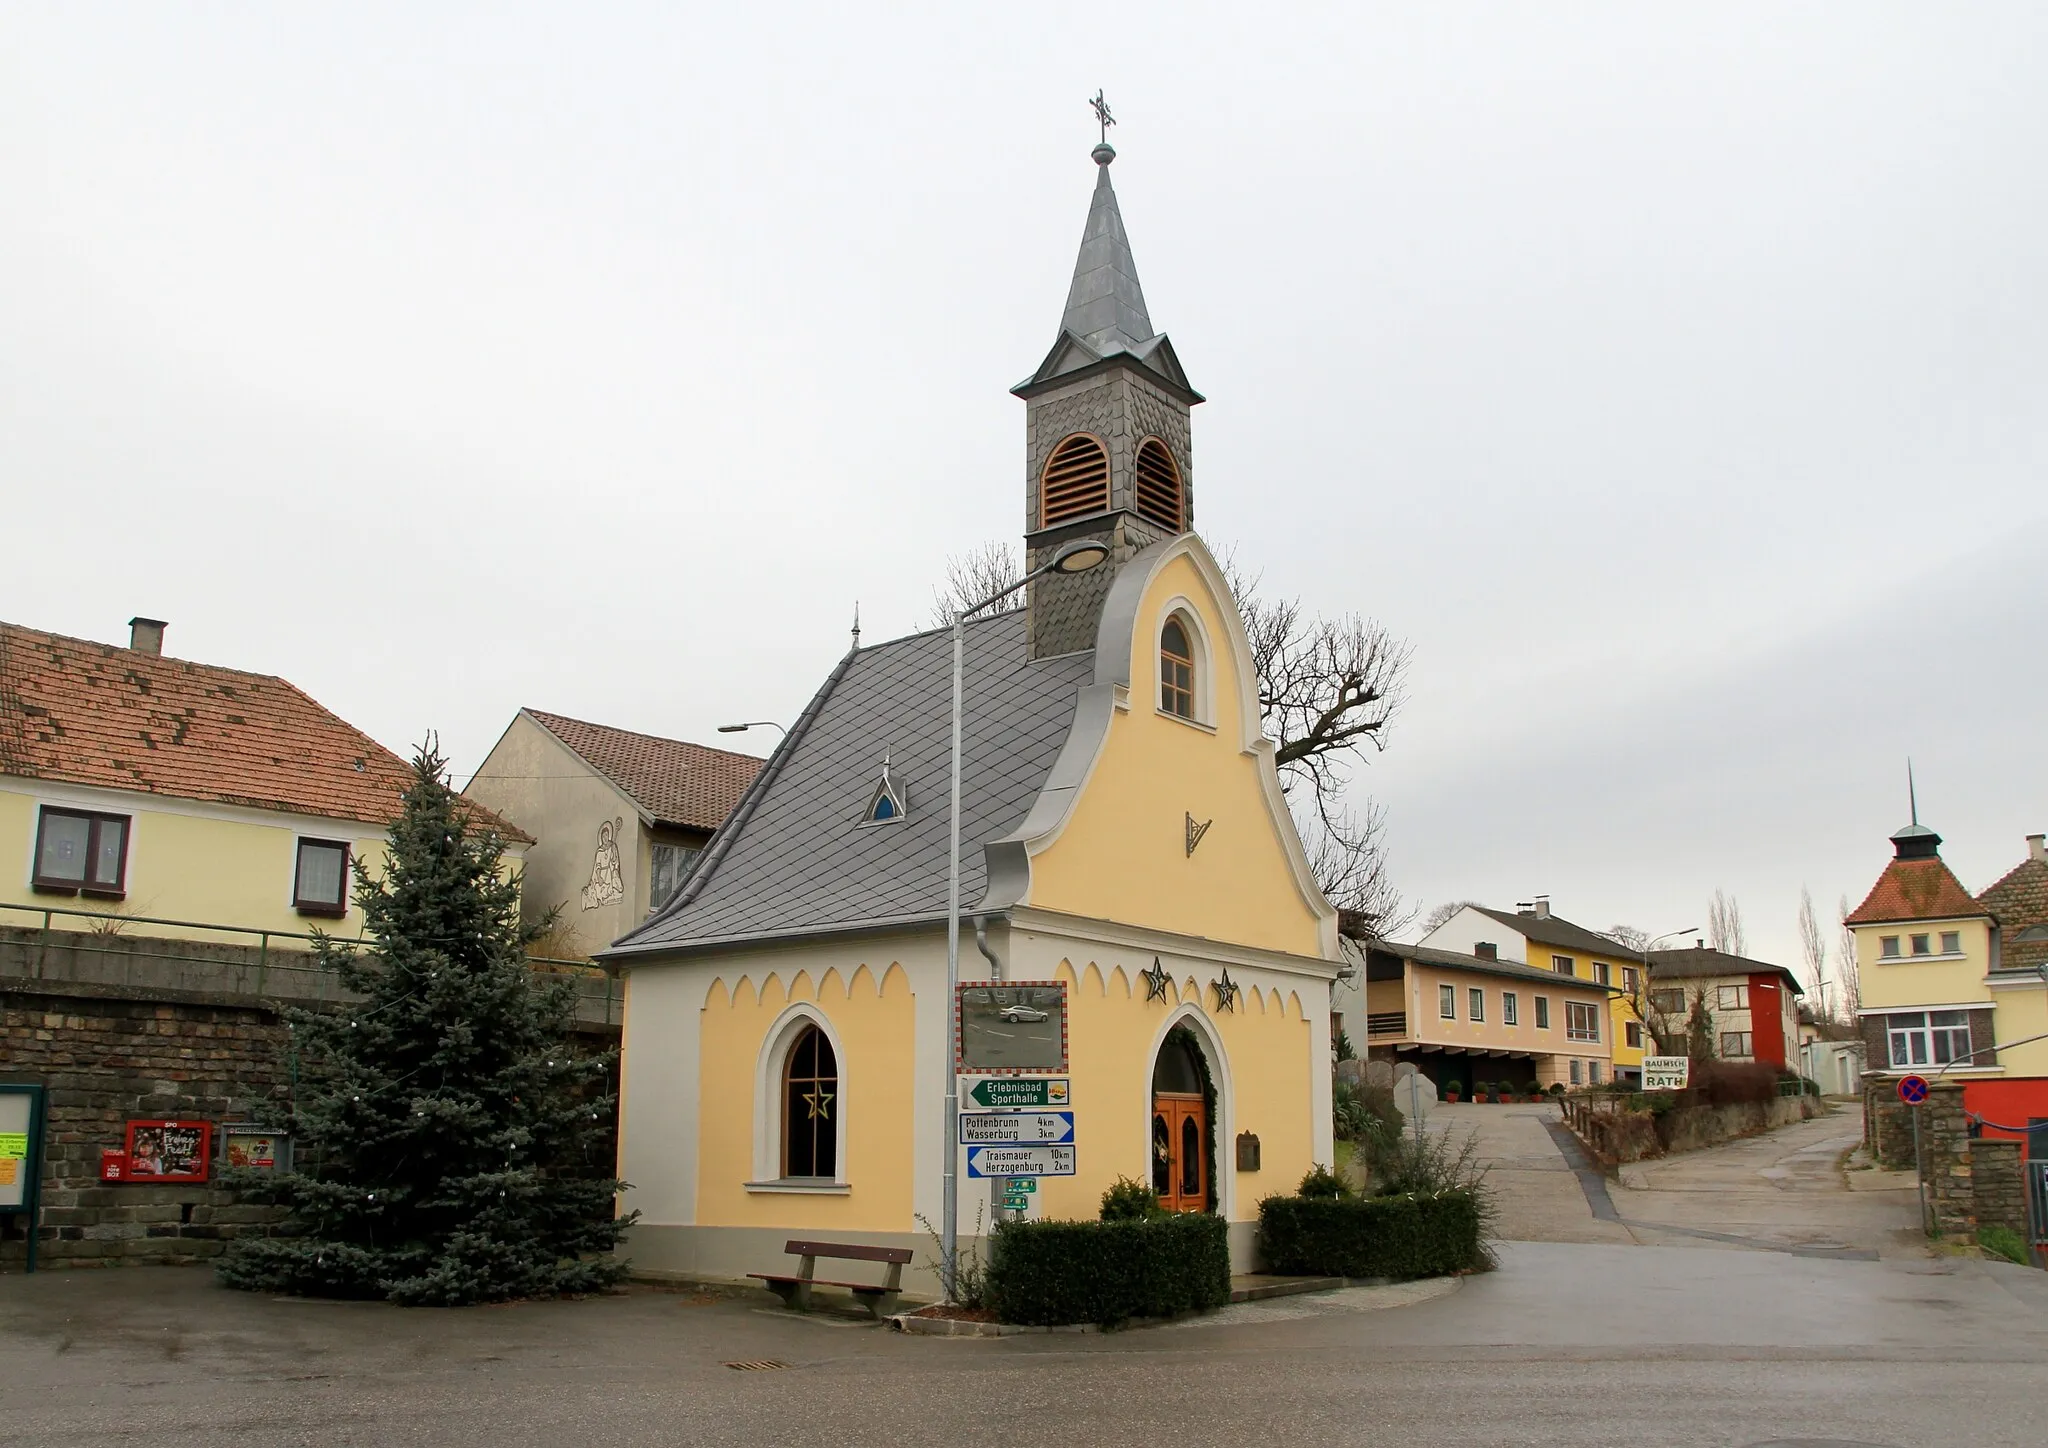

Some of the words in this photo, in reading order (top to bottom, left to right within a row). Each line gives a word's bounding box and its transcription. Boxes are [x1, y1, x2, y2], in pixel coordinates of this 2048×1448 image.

[1647, 1077, 1683, 1086] RATH
[987, 1082, 1042, 1093] Erlebnisbad
[991, 1093, 1038, 1105] Sporthalle
[966, 1118, 1019, 1128] Pottenbrunn
[966, 1129, 1018, 1140] Wasserburg
[986, 1151, 1032, 1161] Traismauer
[986, 1162, 1044, 1174] Herzogenburg
